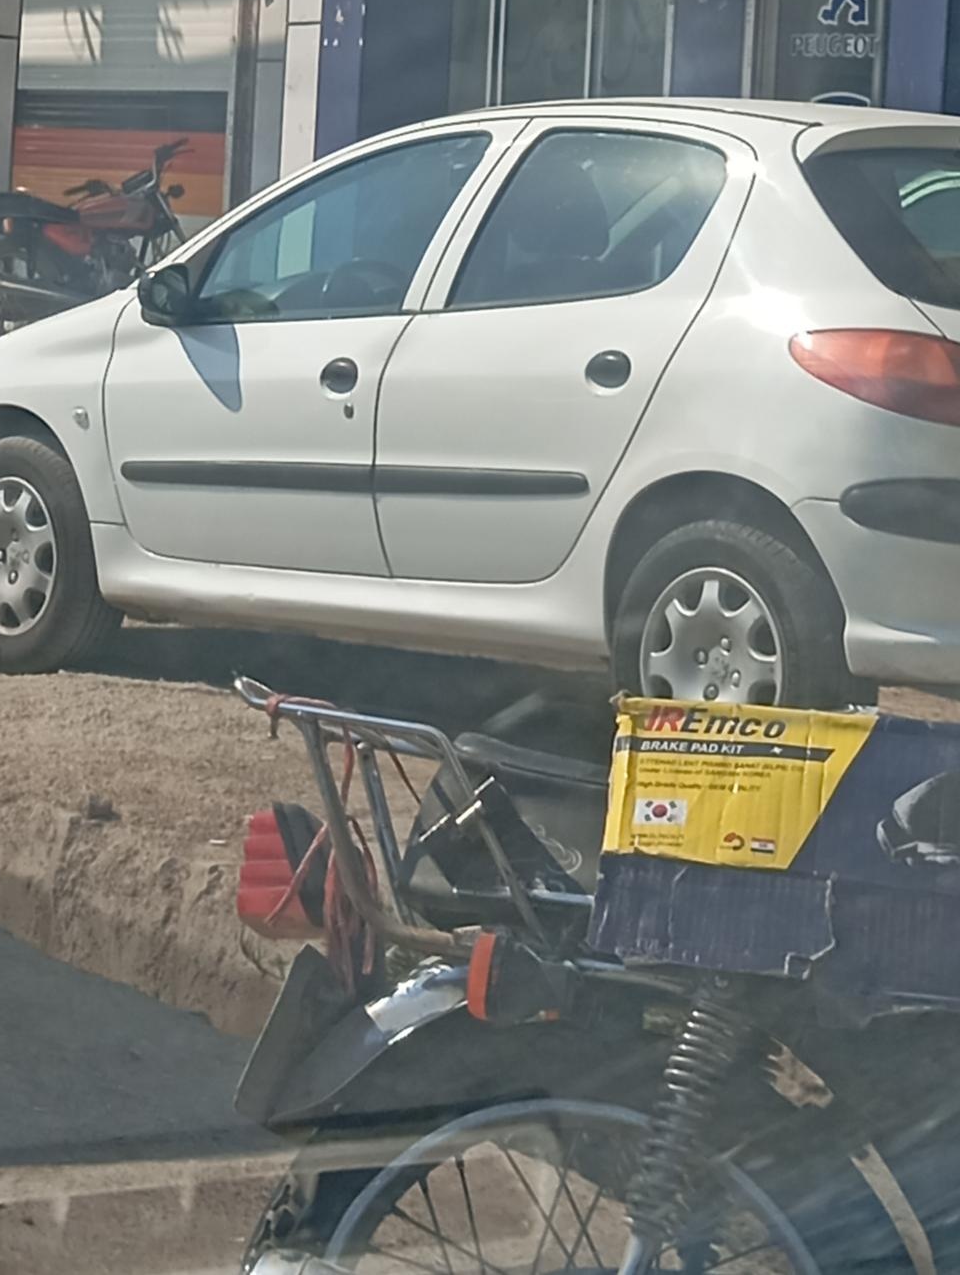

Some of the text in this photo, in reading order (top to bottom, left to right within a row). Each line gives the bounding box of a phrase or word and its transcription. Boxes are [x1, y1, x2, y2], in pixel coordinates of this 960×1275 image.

[790, 33, 878, 58] PEUGEOT
[643, 704, 787, 739] IREmco
[640, 740, 744, 756] BRAKE PAD KIT
